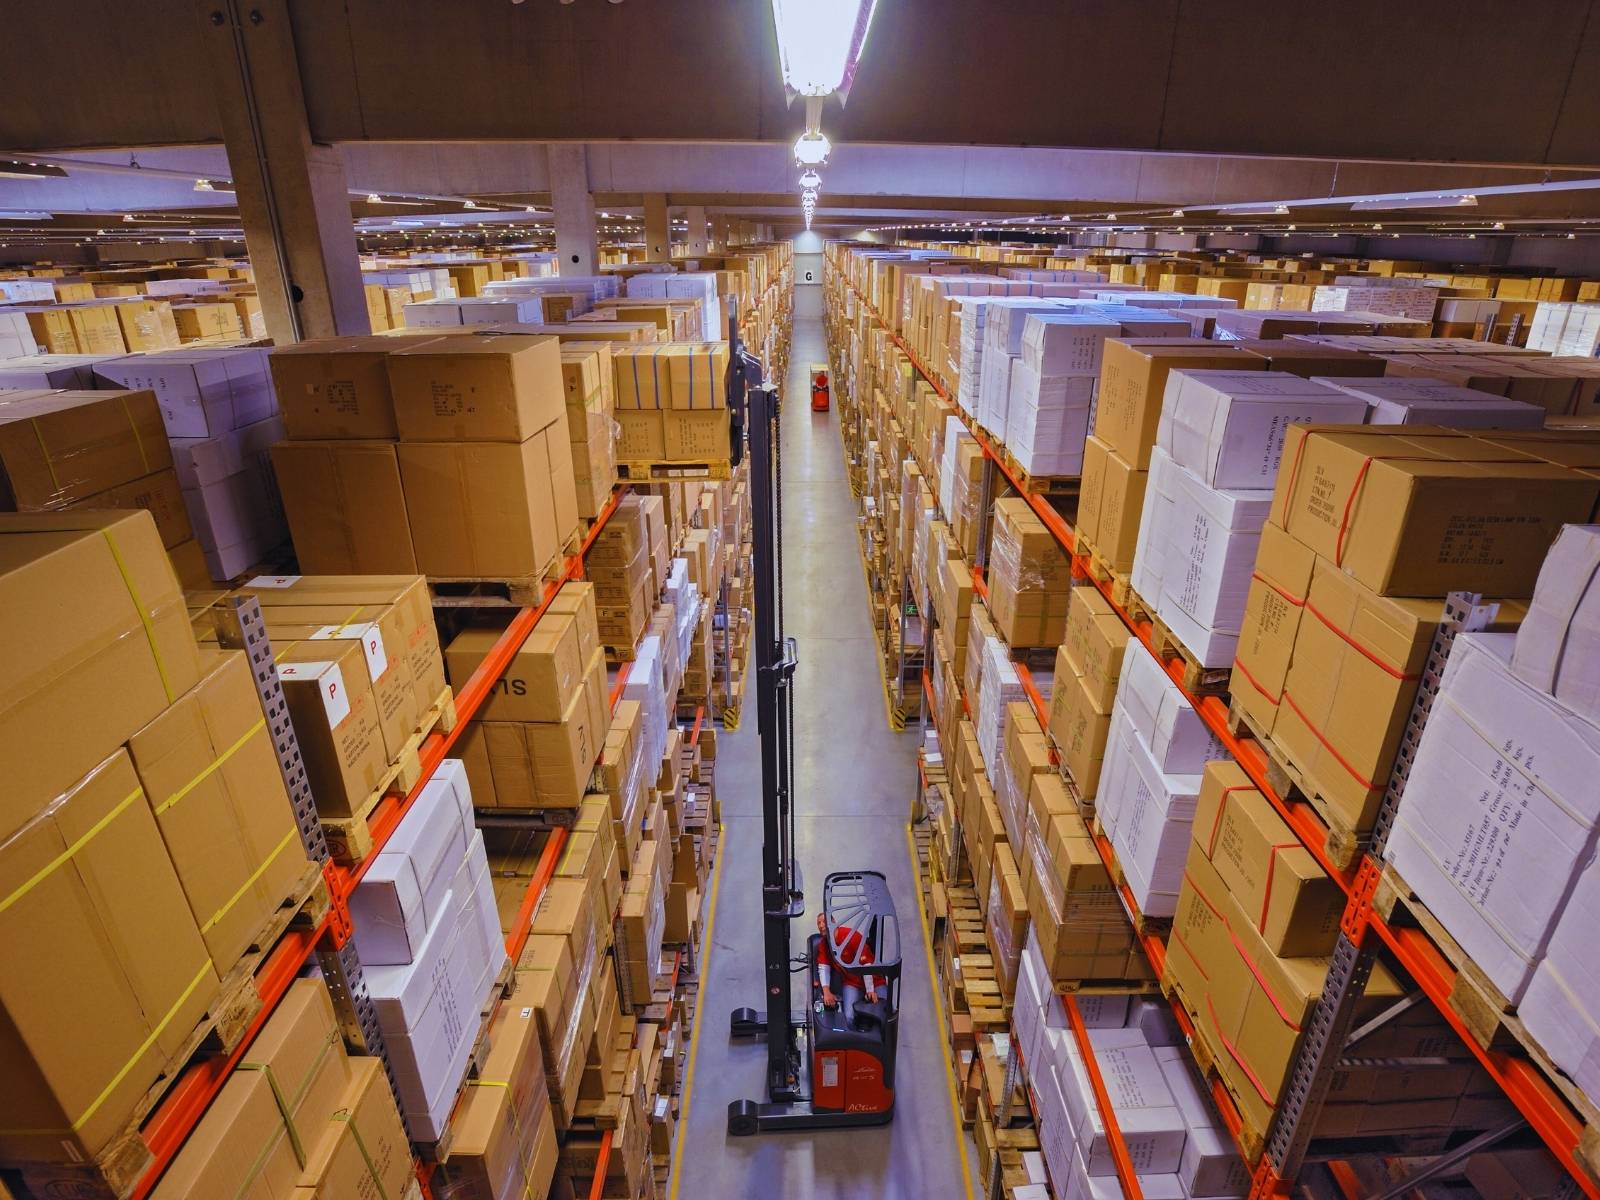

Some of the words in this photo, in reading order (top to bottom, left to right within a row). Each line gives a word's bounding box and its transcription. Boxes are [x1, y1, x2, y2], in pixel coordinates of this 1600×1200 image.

[805, 271, 813, 281] G
[370, 640, 377, 655] P
[328, 683, 336, 699] P
